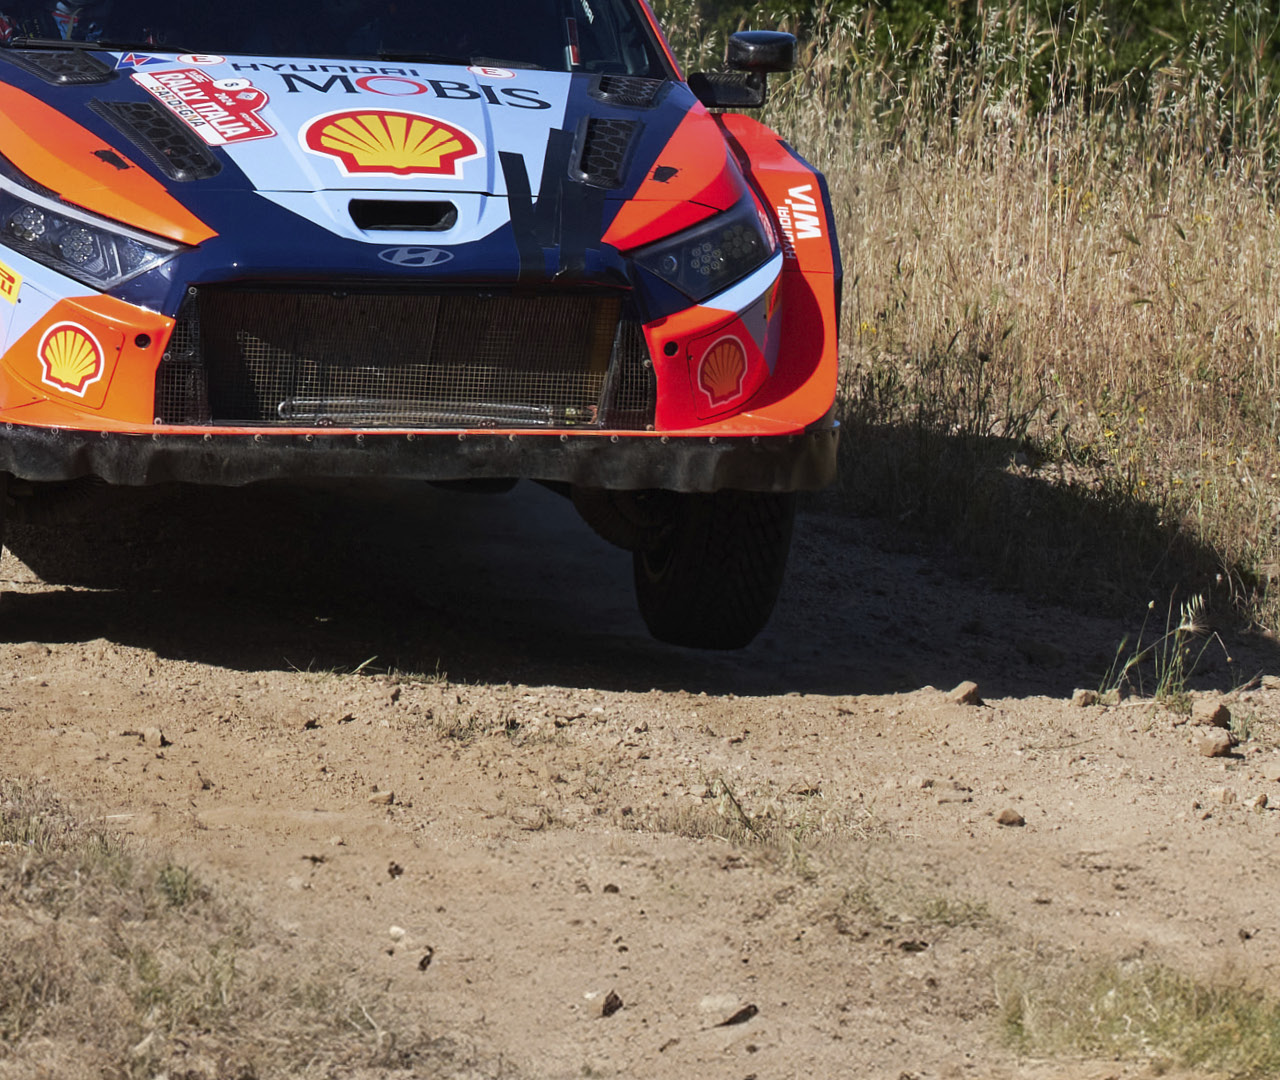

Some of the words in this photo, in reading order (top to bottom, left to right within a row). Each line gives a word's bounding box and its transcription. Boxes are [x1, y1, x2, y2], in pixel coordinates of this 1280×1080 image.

[231, 63, 420, 77] HYUNDAI
[150, 86, 206, 127] SARDEGNA
[154, 72, 210, 101] RALLY
[192, 101, 252, 138] ITALIA
[278, 73, 552, 110] MOBIS
[777, 206, 796, 260] HYUNDAI
